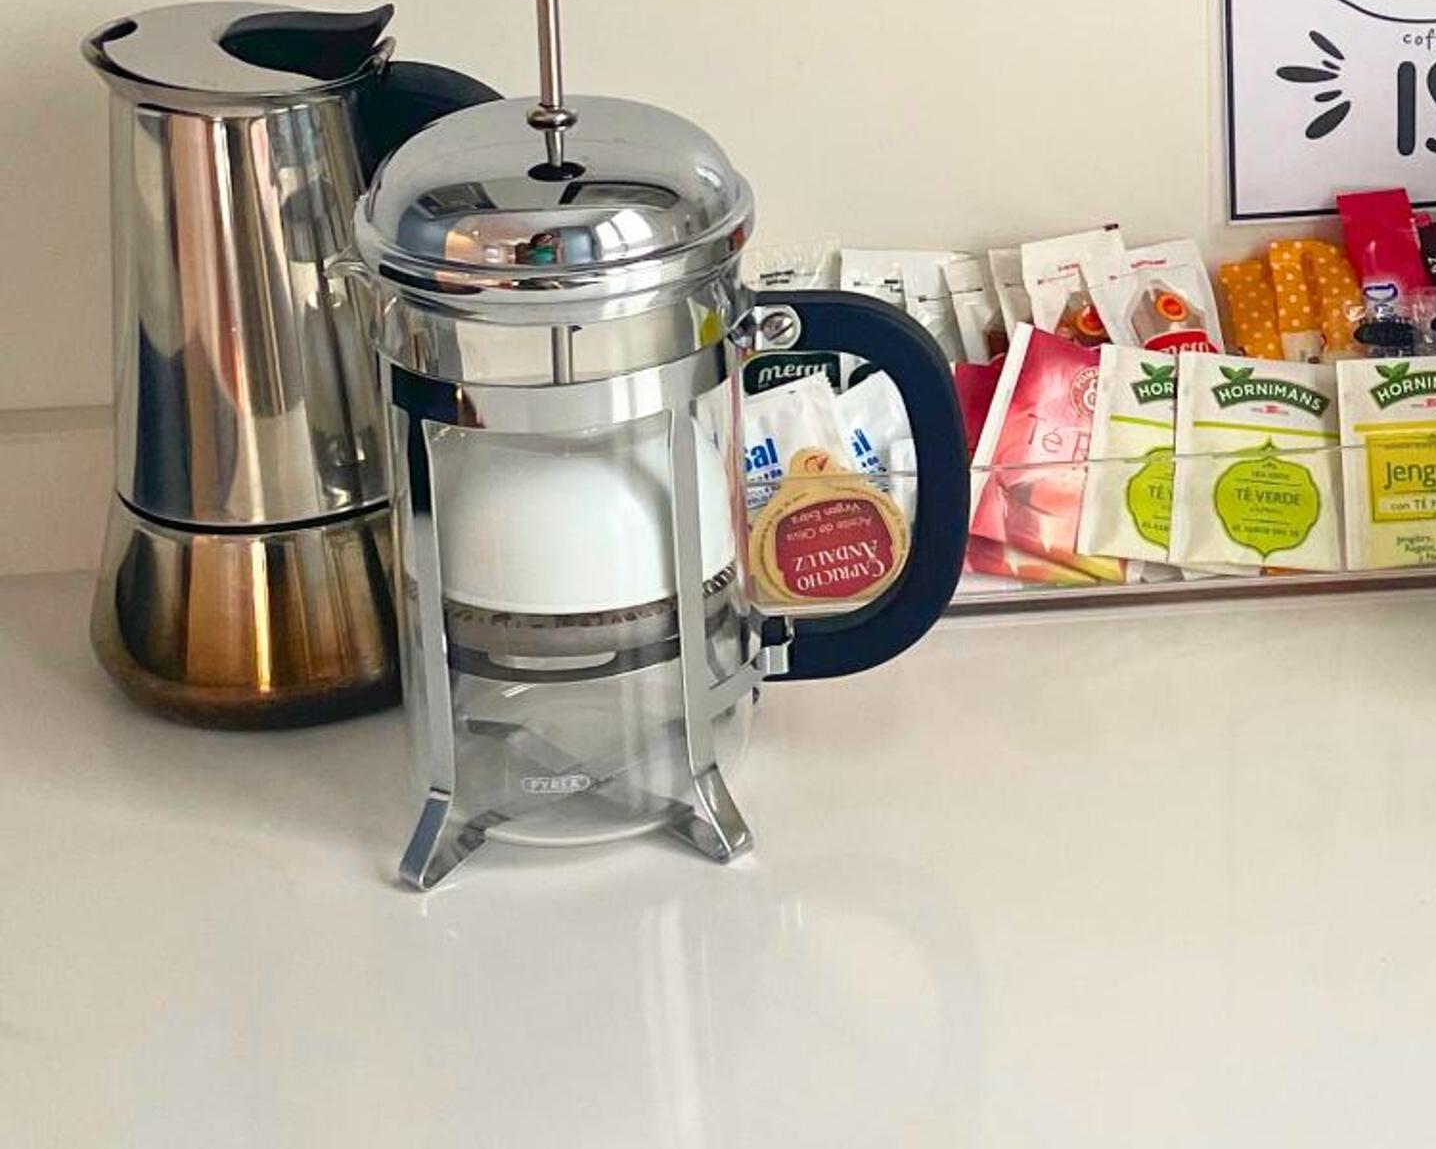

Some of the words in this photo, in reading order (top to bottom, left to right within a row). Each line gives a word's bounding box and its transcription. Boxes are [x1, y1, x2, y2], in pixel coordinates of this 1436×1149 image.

[1218, 382, 1322, 412] HORNIMANS
[822, 502, 862, 518] Virgen
[1234, 487, 1250, 501] TÉ
[1255, 488, 1303, 507] VERDE
[792, 538, 879, 572] ANDALUZ
[797, 558, 885, 592] CAPRICHO
